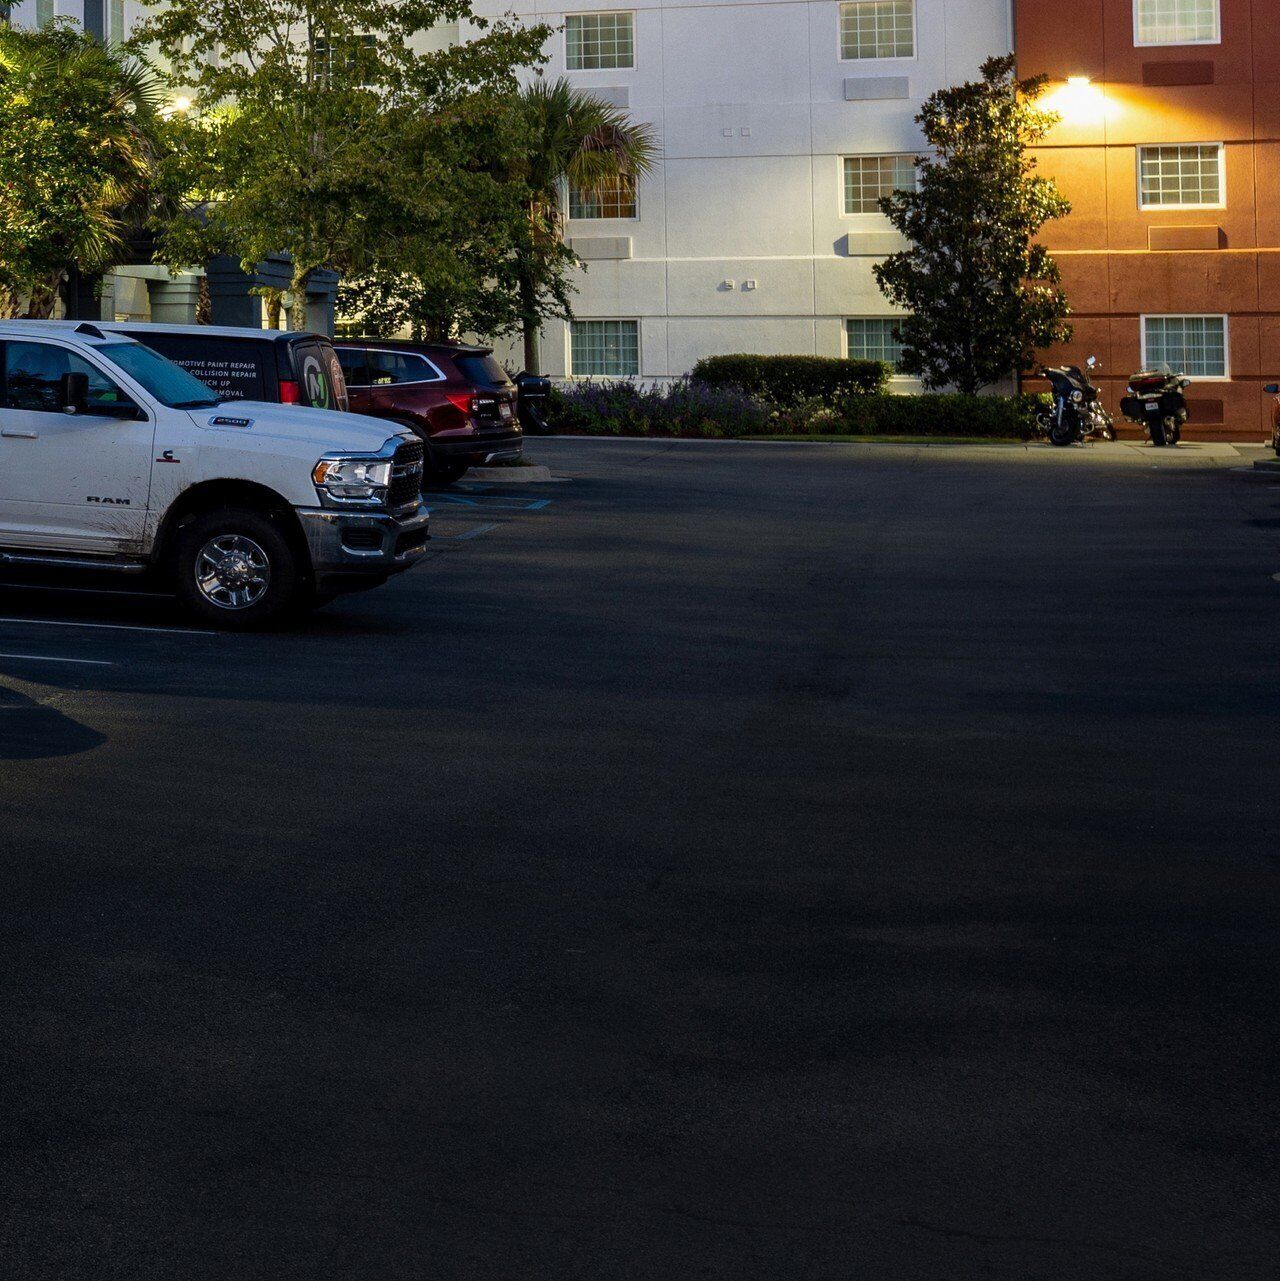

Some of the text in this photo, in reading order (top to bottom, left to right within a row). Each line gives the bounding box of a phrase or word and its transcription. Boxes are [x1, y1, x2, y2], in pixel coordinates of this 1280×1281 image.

[171, 360, 256, 370] OMOTIVE PAINT REPAIR
[190, 369, 257, 379] COLLISION REPAIR
[86, 496, 130, 505] RAM
